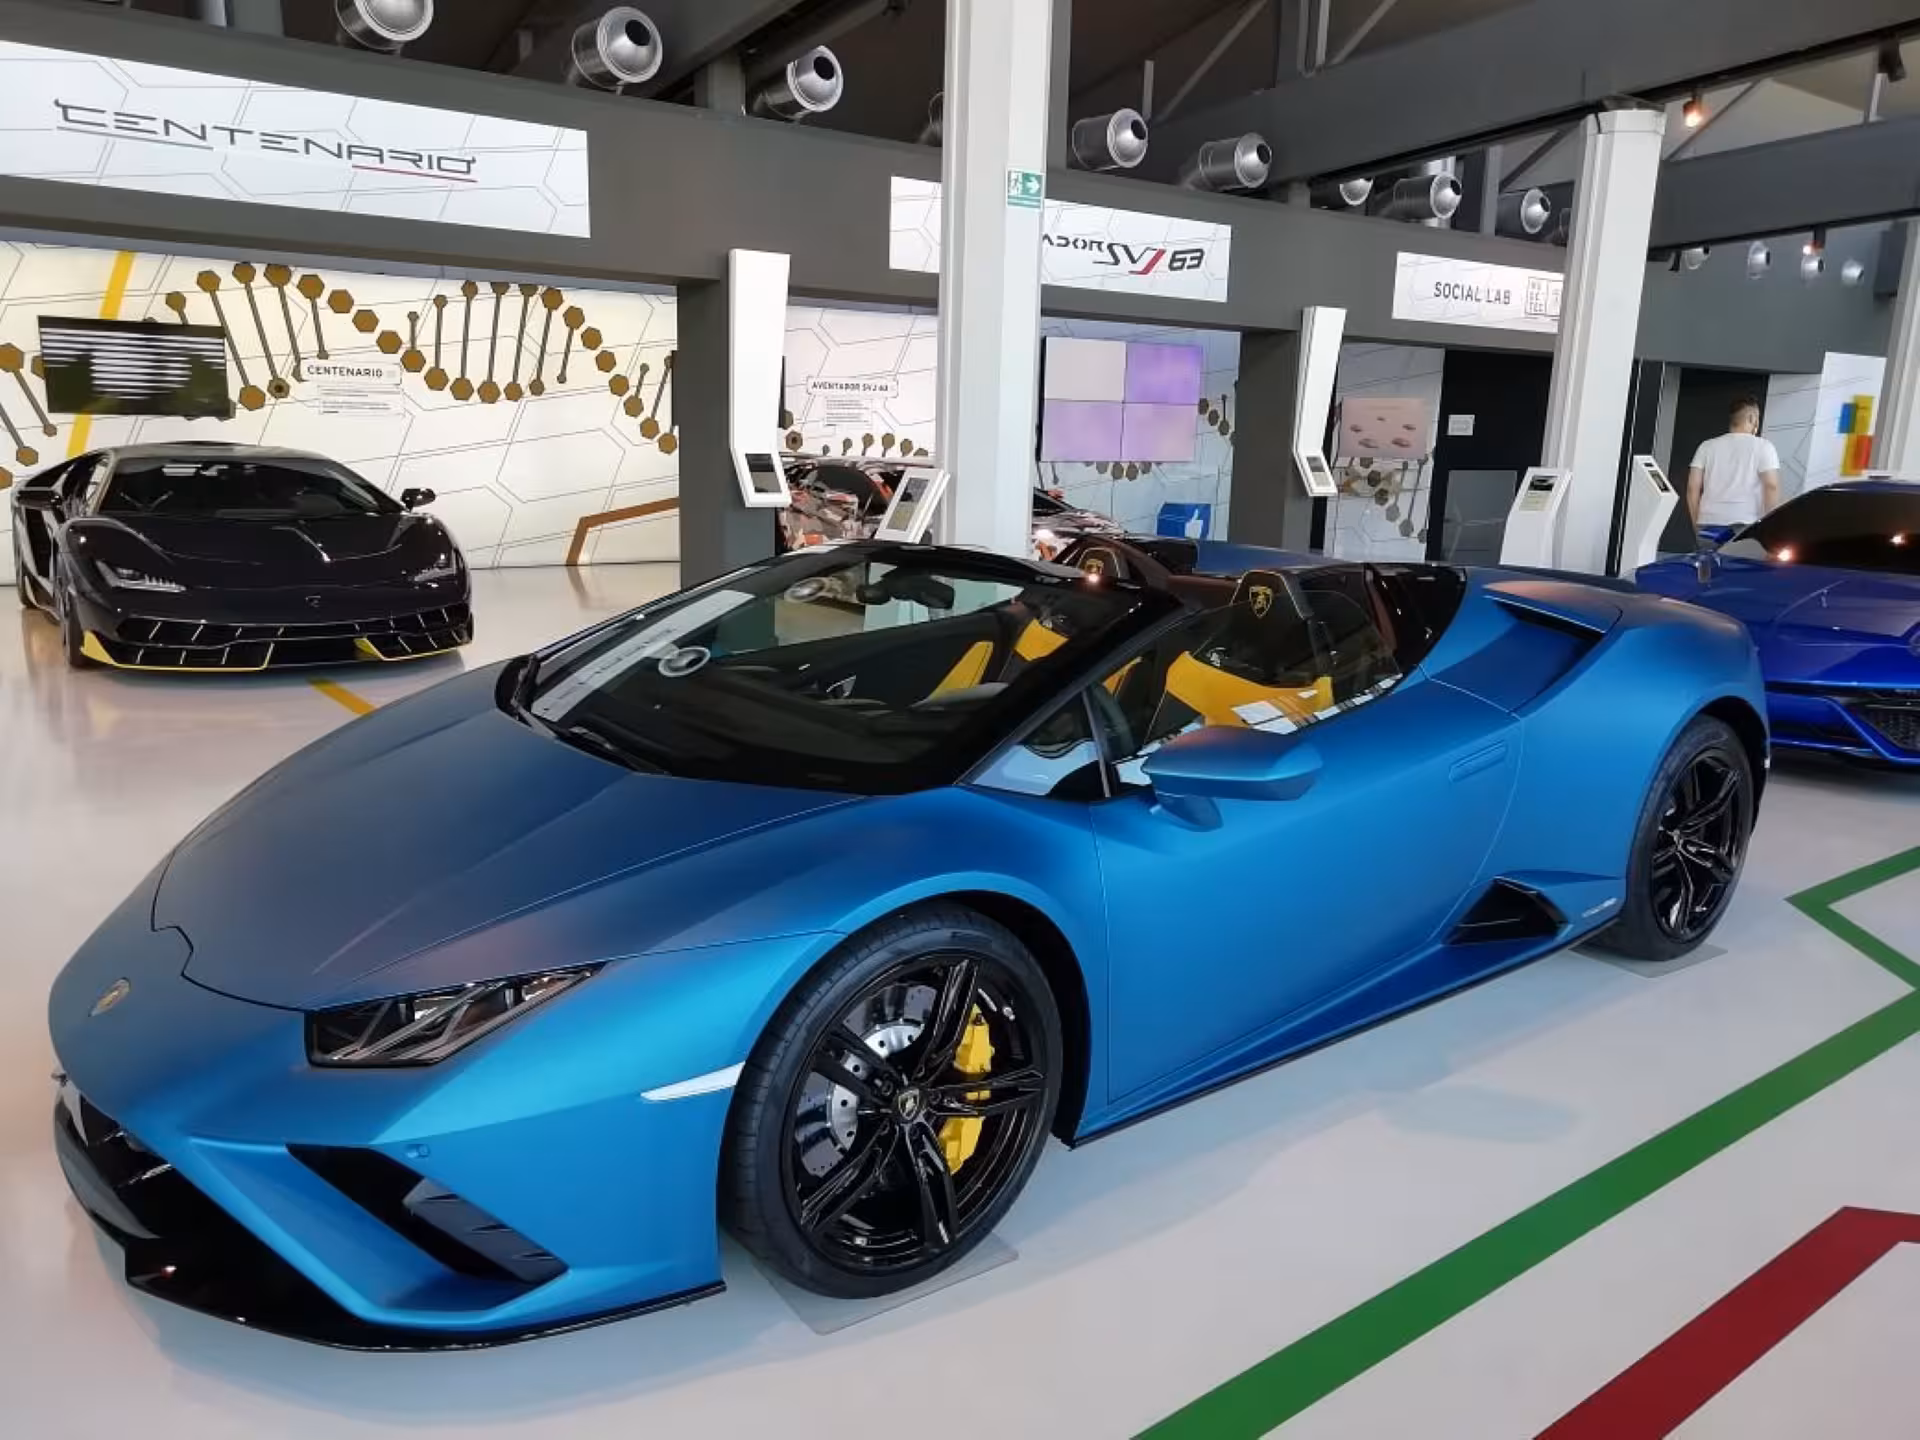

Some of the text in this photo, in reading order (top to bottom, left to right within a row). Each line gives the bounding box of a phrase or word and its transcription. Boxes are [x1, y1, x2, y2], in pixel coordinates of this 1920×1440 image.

[54, 98, 475, 174] CENTENARIO
[1042, 233, 1205, 275] ADOR SVJ 63
[1433, 281, 1482, 303] SOCIAL
[1486, 289, 1511, 305] LAB
[307, 365, 383, 378] CENTENARIO
[811, 382, 861, 391] AVENTADOR
